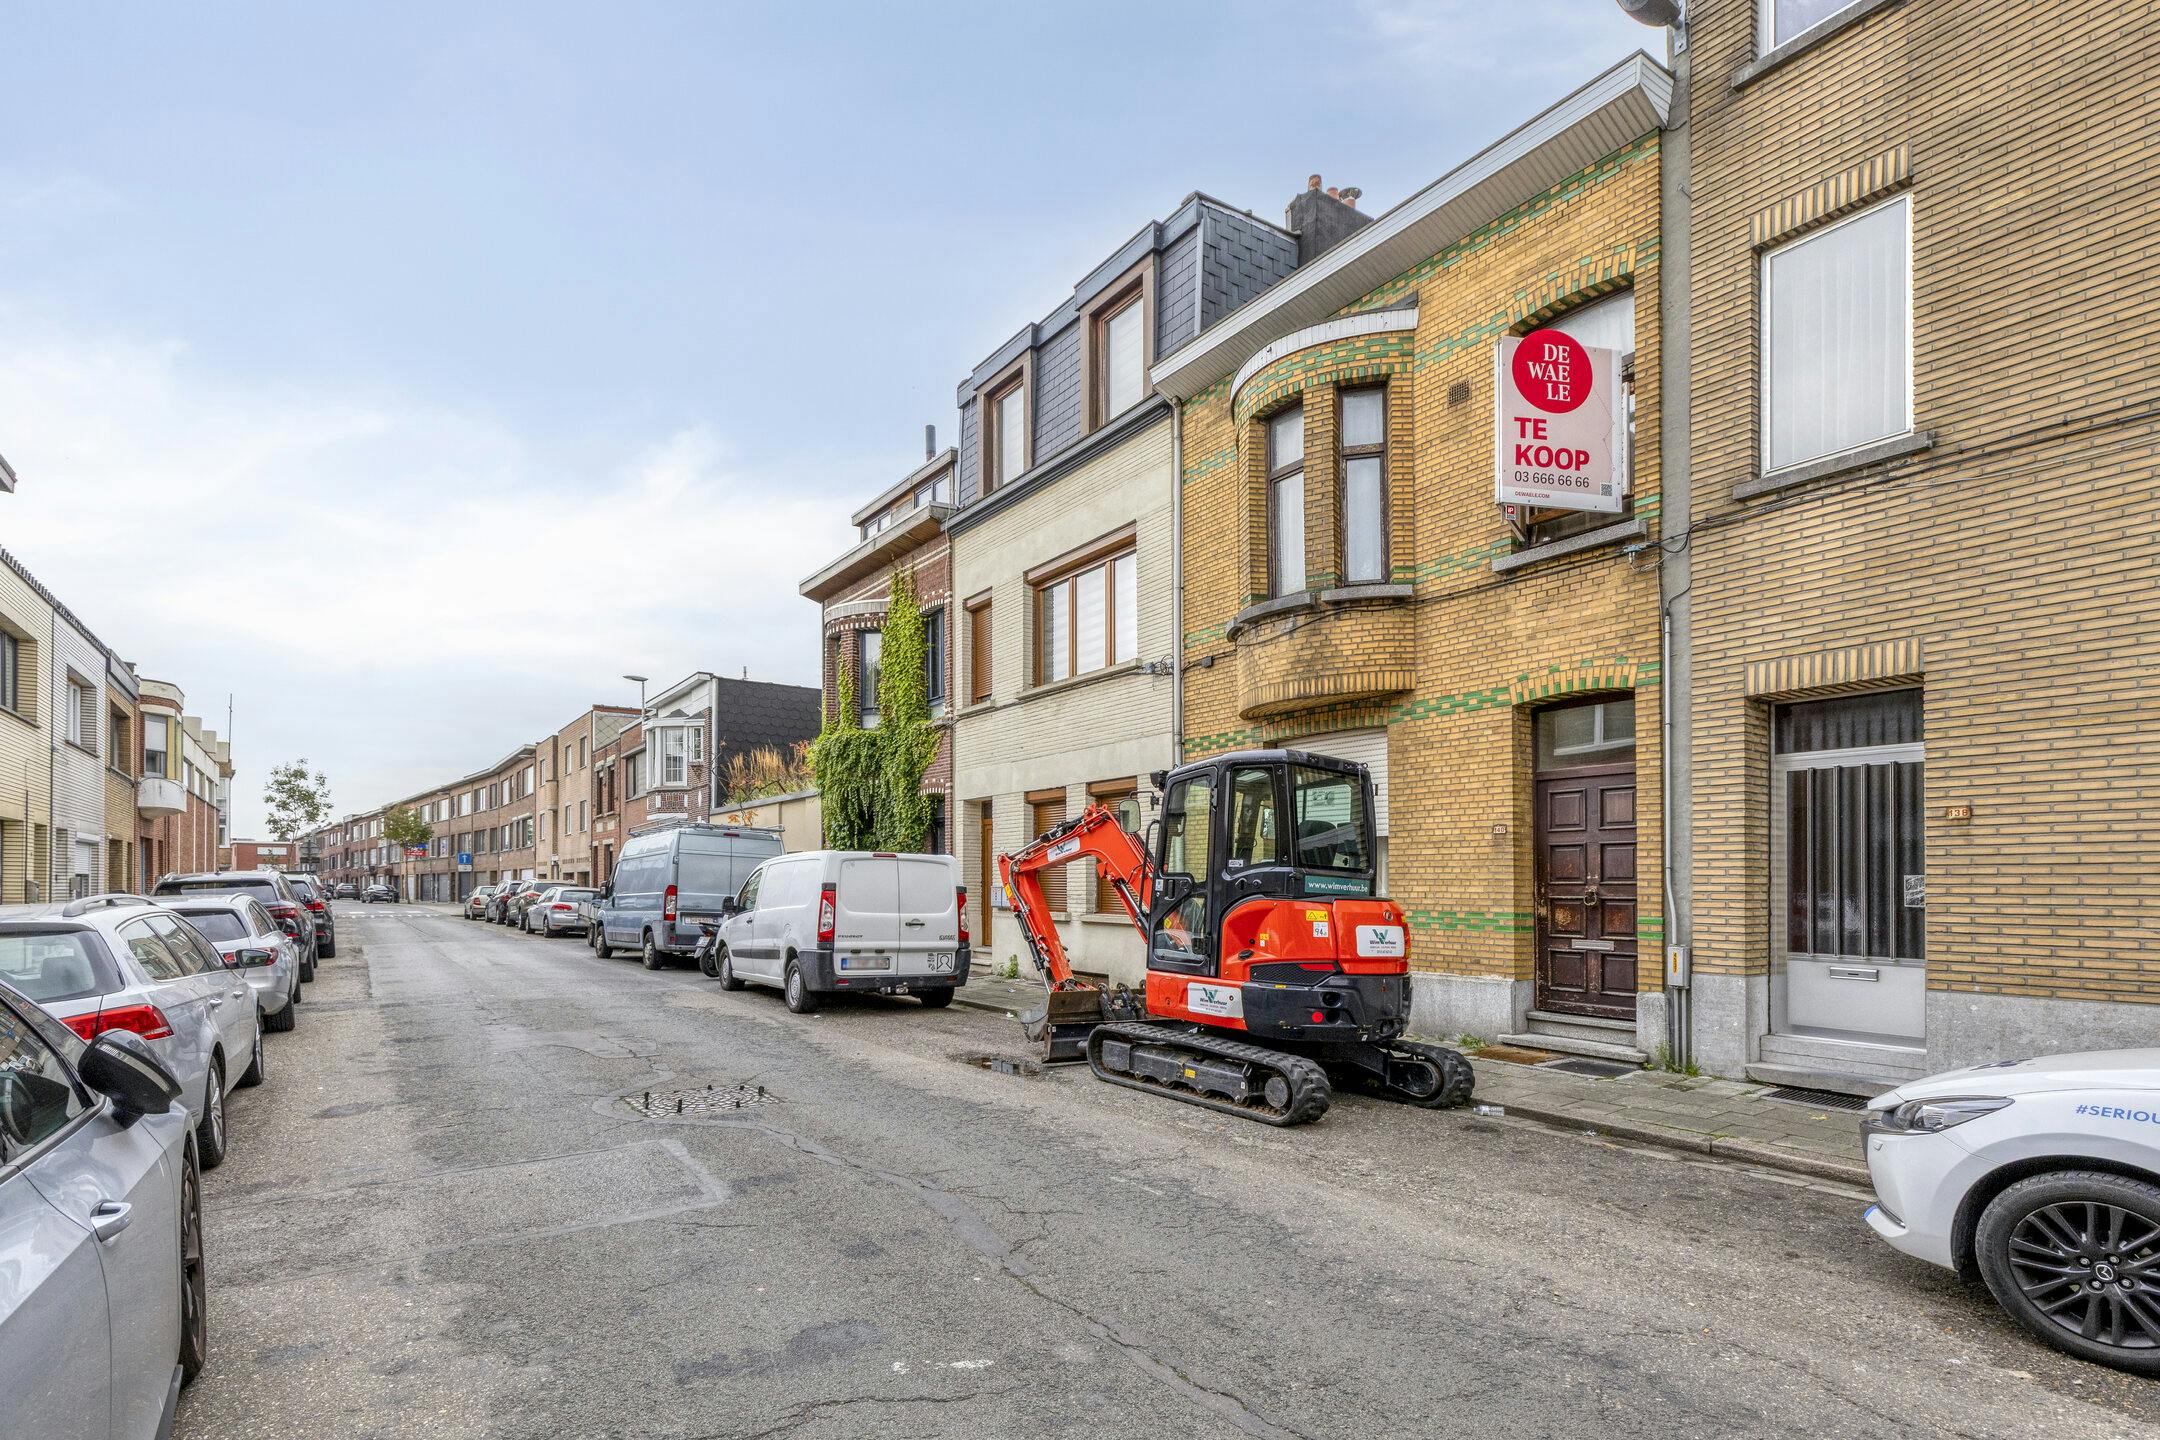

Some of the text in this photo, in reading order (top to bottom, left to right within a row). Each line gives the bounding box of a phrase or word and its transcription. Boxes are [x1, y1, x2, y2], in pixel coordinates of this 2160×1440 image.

[1544, 344, 1570, 363] DE
[1527, 361, 1570, 382] WAE
[1546, 383, 1570, 401] LE
[1514, 416, 1547, 440] TE
[1515, 444, 1590, 471] KOOP
[1514, 470, 1590, 488] 03 666 66 66
[1308, 881, 1368, 892] www.wimverhuur.be
